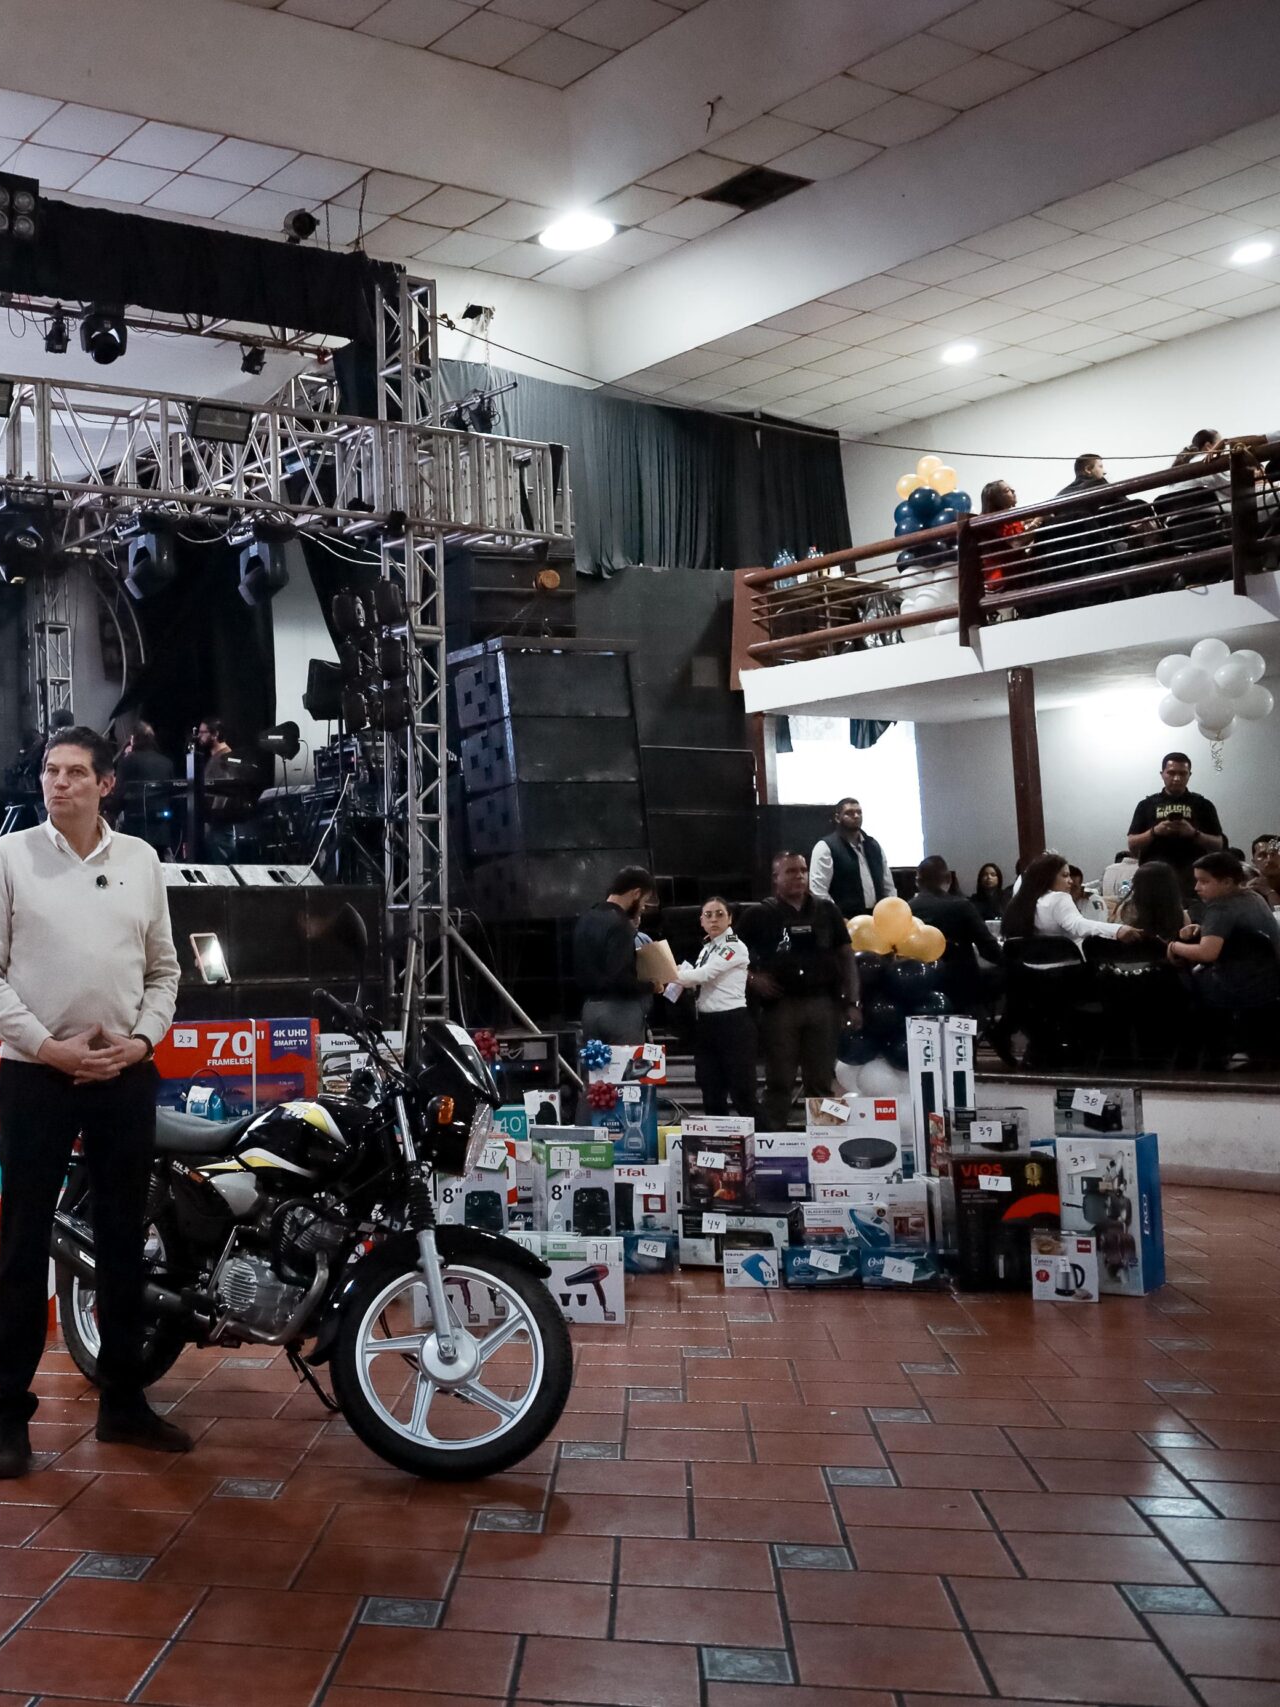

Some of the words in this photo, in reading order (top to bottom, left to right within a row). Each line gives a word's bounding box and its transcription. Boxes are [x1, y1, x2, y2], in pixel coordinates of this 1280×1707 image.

[1156, 811, 1192, 819] MOIA
[916, 1025, 932, 1036] 27
[956, 1021, 970, 1032] 28
[207, 1058, 255, 1066] FRAMELESS
[1083, 1095, 1098, 1106] 38
[978, 1126, 992, 1137] 39
[1070, 1156, 1087, 1166] 37
[616, 1168, 646, 1177] T-fal
[961, 1164, 1003, 1177] VIOS
[645, 1181, 657, 1189] 43
[821, 1189, 850, 1197] T-fal
[643, 1243, 658, 1253] 48
[793, 1256, 810, 1267] Ost
[867, 1257, 885, 1268] Ost
